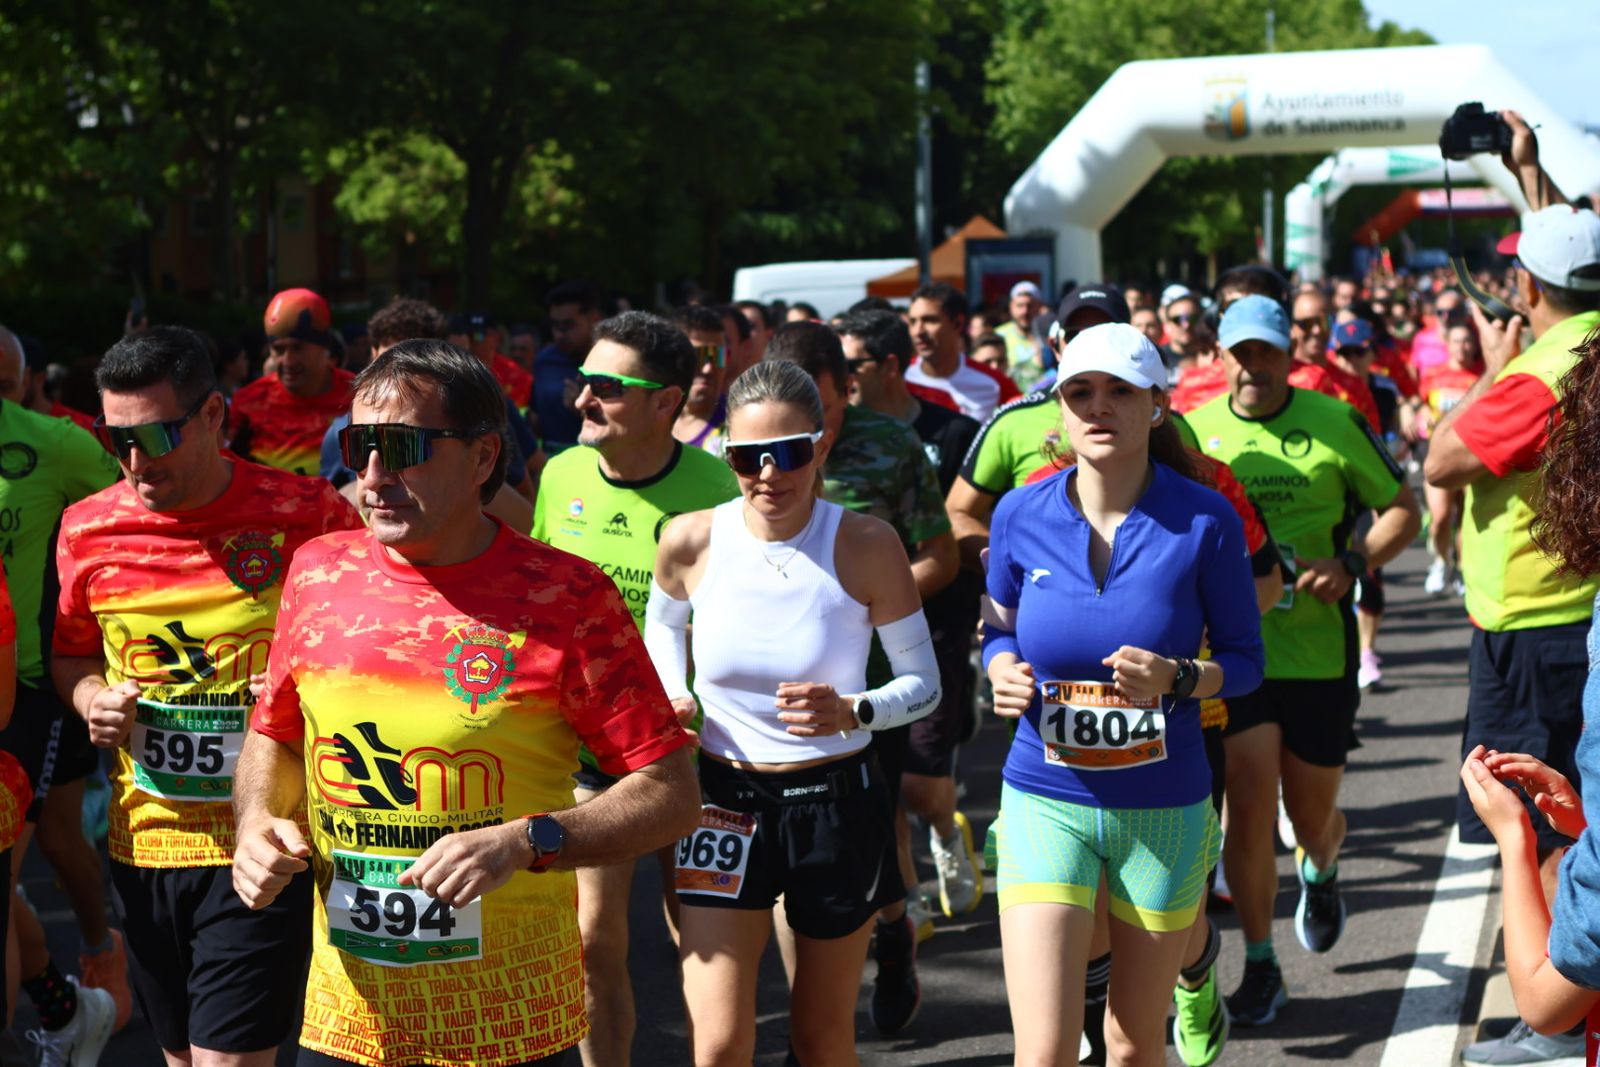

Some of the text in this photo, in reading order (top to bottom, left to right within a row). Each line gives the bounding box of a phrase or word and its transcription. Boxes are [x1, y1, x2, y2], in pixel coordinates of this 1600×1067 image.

[1263, 90, 1404, 113] Ayuntamiento
[1263, 117, 1406, 135] de Salamanca
[1075, 694, 1128, 706] CARRERA
[157, 719, 211, 730] CARRERA
[1046, 707, 1160, 747] 1804
[143, 728, 225, 775] 595
[328, 807, 504, 824] CARRERA CIVICO-MILITAR
[369, 860, 392, 873] SAN
[350, 886, 456, 937] 594
[384, 981, 407, 1000] POR
[409, 981, 426, 999] EL
[427, 972, 478, 997] TRABAJO
[490, 970, 505, 989] LA
[505, 957, 554, 985] VICTORIA
[395, 997, 429, 1016] VALOR
[431, 993, 456, 1014] POR
[459, 992, 475, 1010] EL
[477, 983, 526, 1008] TRABAJO
[539, 976, 552, 994] LA
[384, 1013, 428, 1034] LEALTAD
[430, 1013, 440, 1030] Y
[442, 1008, 478, 1029] VALOR
[480, 1005, 505, 1025] POR
[507, 1002, 524, 1020] EL
[524, 988, 567, 1015] TRABAJO
[430, 1028, 476, 1050] LEALTAD
[478, 1025, 489, 1043] Y
[490, 1018, 526, 1041] VALOR
[528, 1012, 551, 1035] POR
[551, 1008, 563, 1026] EL
[324, 1029, 381, 1060] FORTALEZA
[477, 1041, 501, 1062] POR
[504, 1037, 520, 1057] EL
[521, 1026, 564, 1053] TRABAJO
